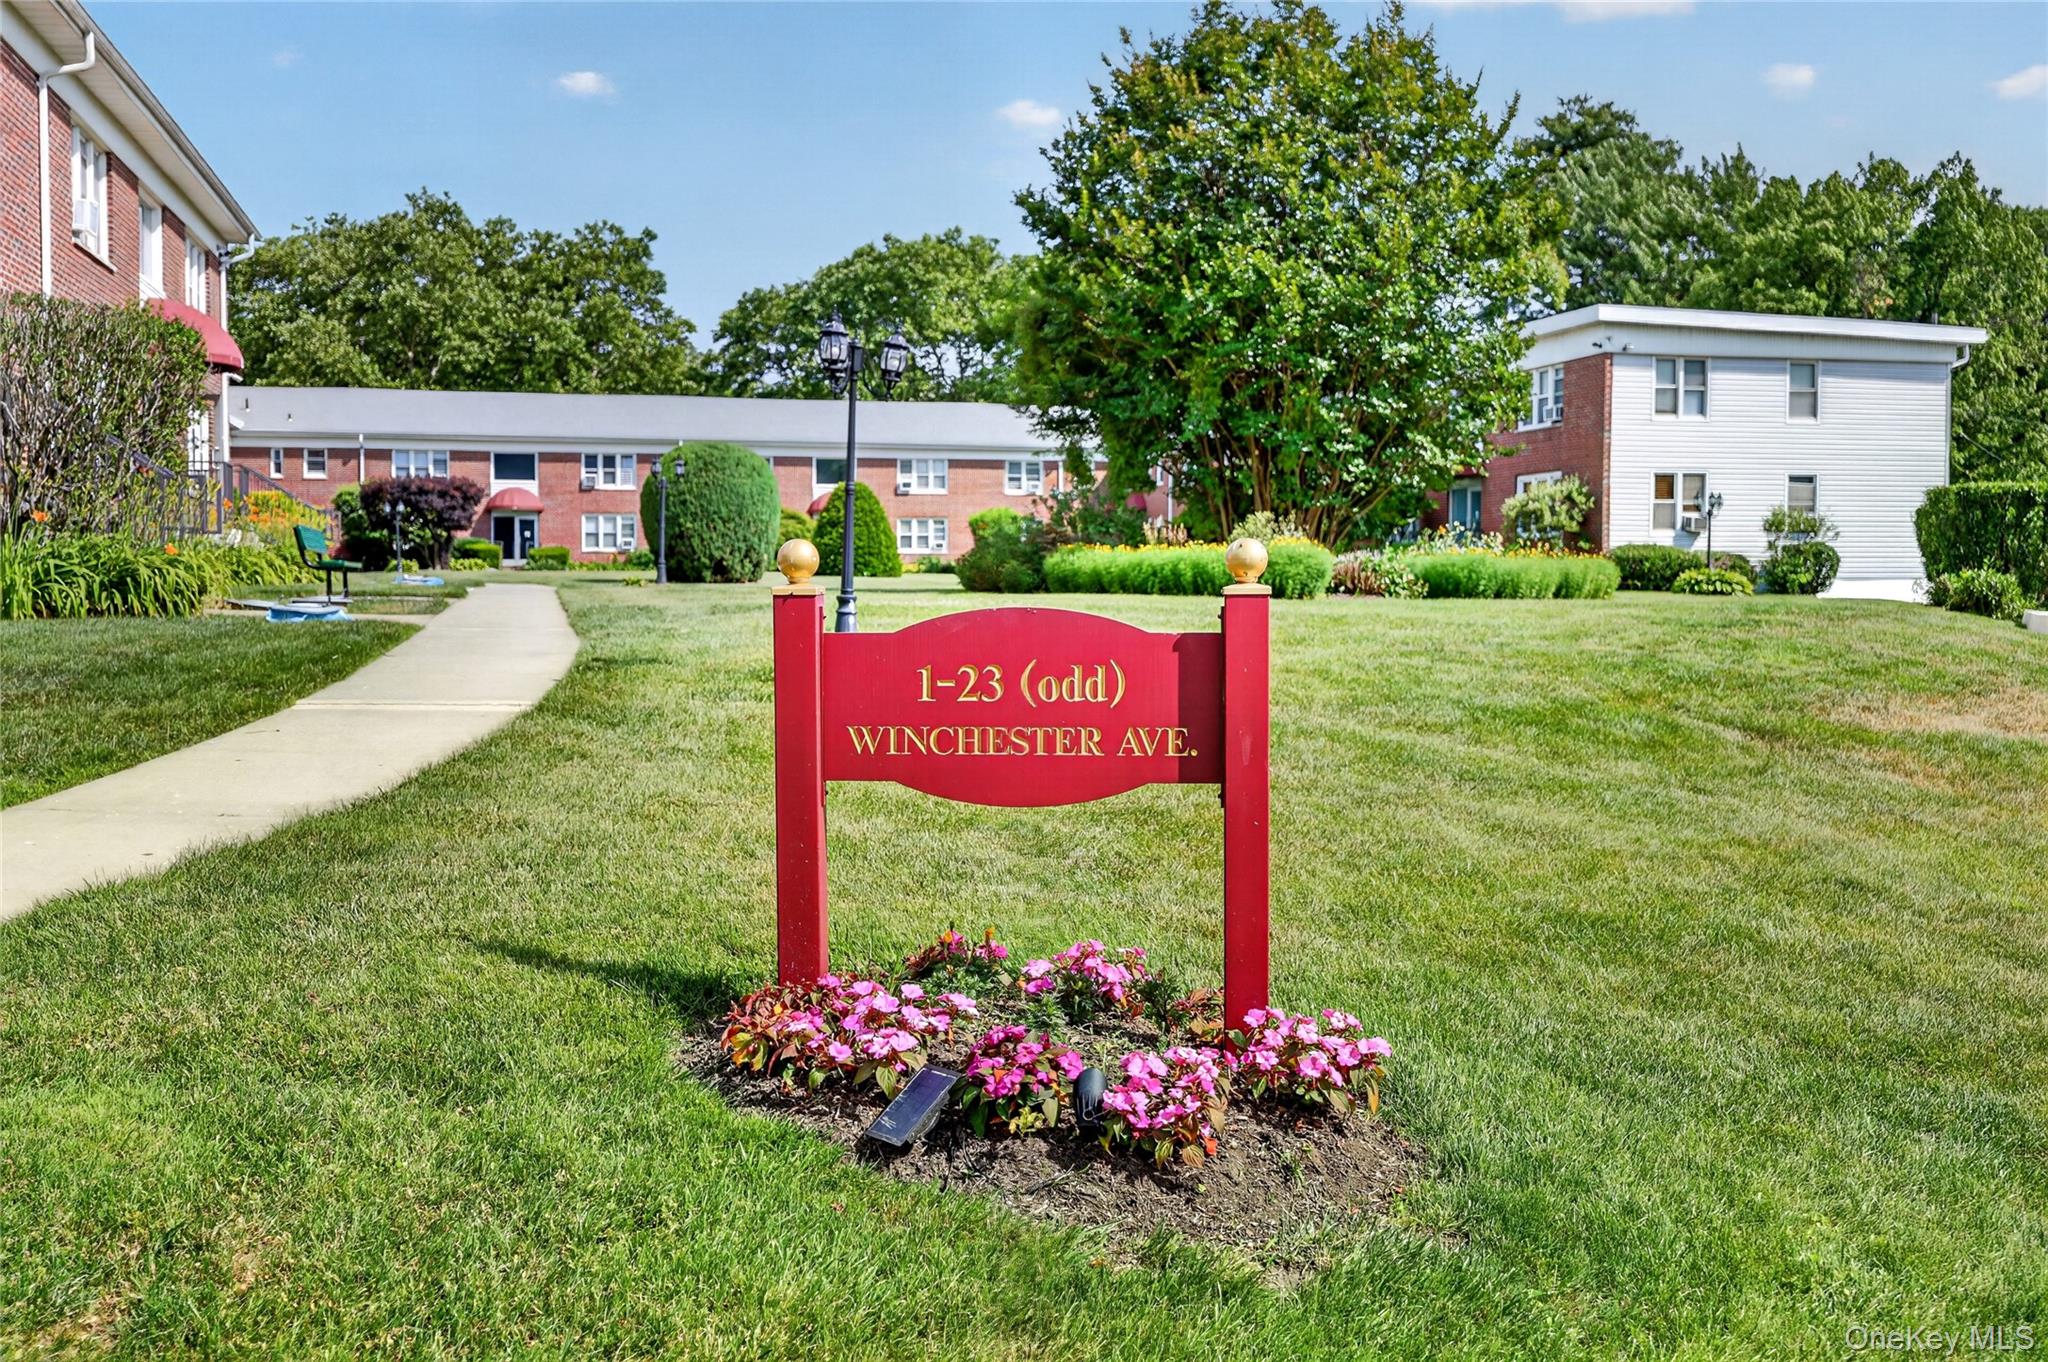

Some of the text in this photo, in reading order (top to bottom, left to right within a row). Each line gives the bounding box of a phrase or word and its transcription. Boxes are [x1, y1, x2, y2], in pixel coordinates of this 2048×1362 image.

[916, 658, 1126, 709] 1-23 (odd)
[847, 725, 1199, 758] WINCHESTER AVE.
